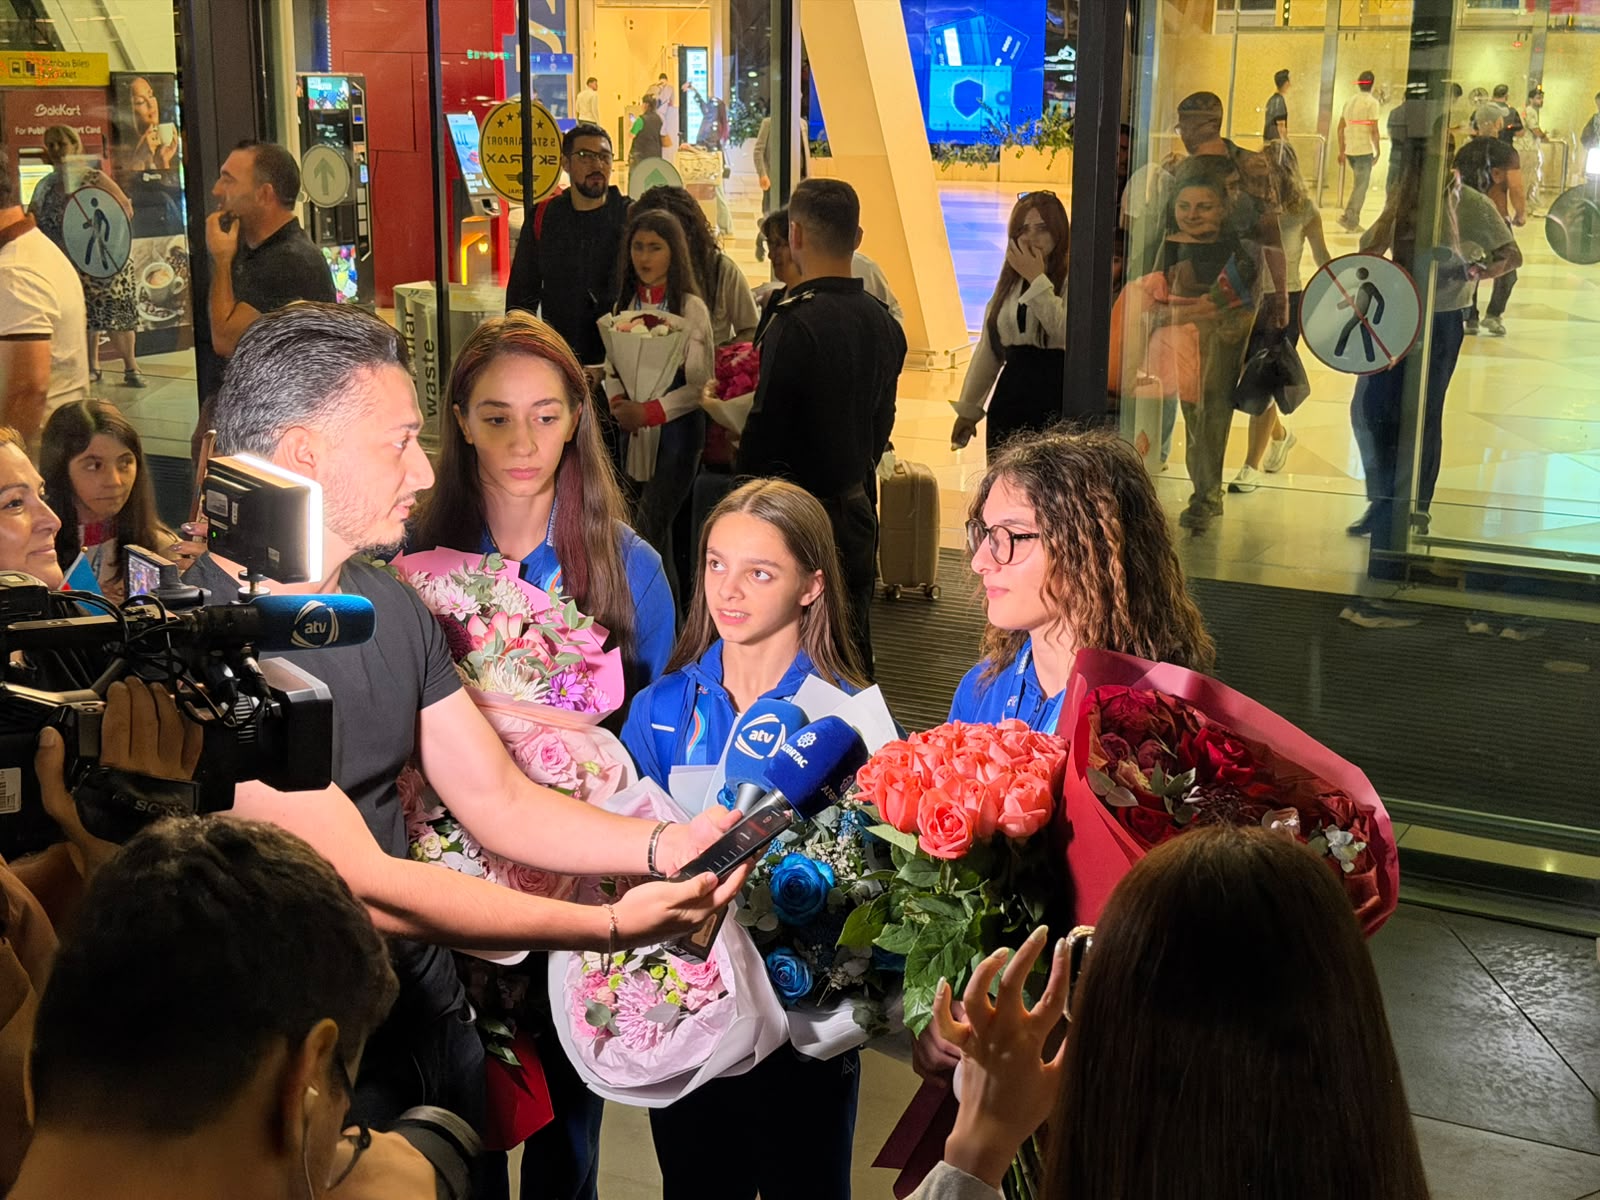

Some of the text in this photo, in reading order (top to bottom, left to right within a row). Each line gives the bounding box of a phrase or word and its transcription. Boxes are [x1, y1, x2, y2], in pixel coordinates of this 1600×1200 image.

[28, 126, 46, 135] Publi
[422, 339, 437, 417] waste
[304, 620, 328, 634] atv
[748, 729, 775, 744] atv
